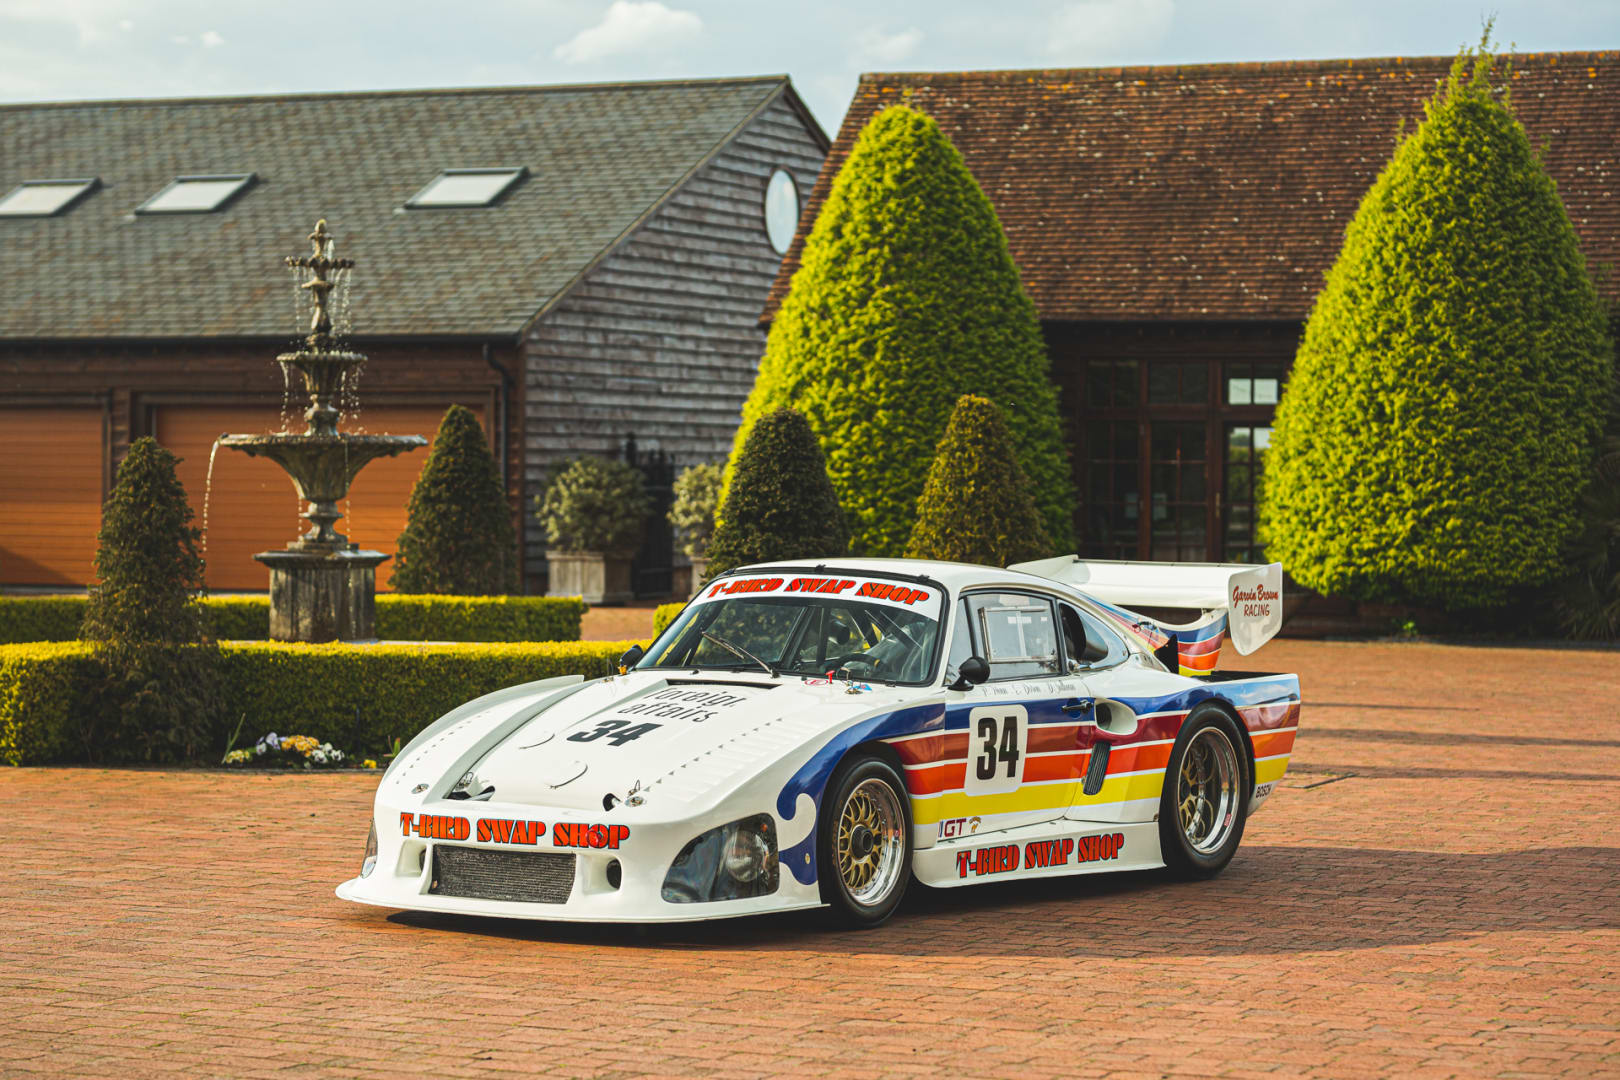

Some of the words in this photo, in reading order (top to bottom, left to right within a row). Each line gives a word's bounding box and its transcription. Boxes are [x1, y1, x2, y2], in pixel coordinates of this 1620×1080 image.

[707, 577, 784, 598] T-BIRD
[784, 577, 856, 595] SWAP
[855, 582, 930, 605] SHOP
[1256, 583, 1279, 601] Brown
[1243, 603, 1270, 617] RACING
[617, 701, 718, 722] affairs
[566, 719, 664, 747] 34
[976, 716, 1019, 780] 34
[400, 811, 470, 841] T-BIRD
[476, 818, 546, 845] SWAP
[553, 822, 630, 849] SHOP
[955, 843, 1020, 879] T-BIRD
[1024, 838, 1074, 870] SWAP
[1077, 832, 1125, 864] SHOP
